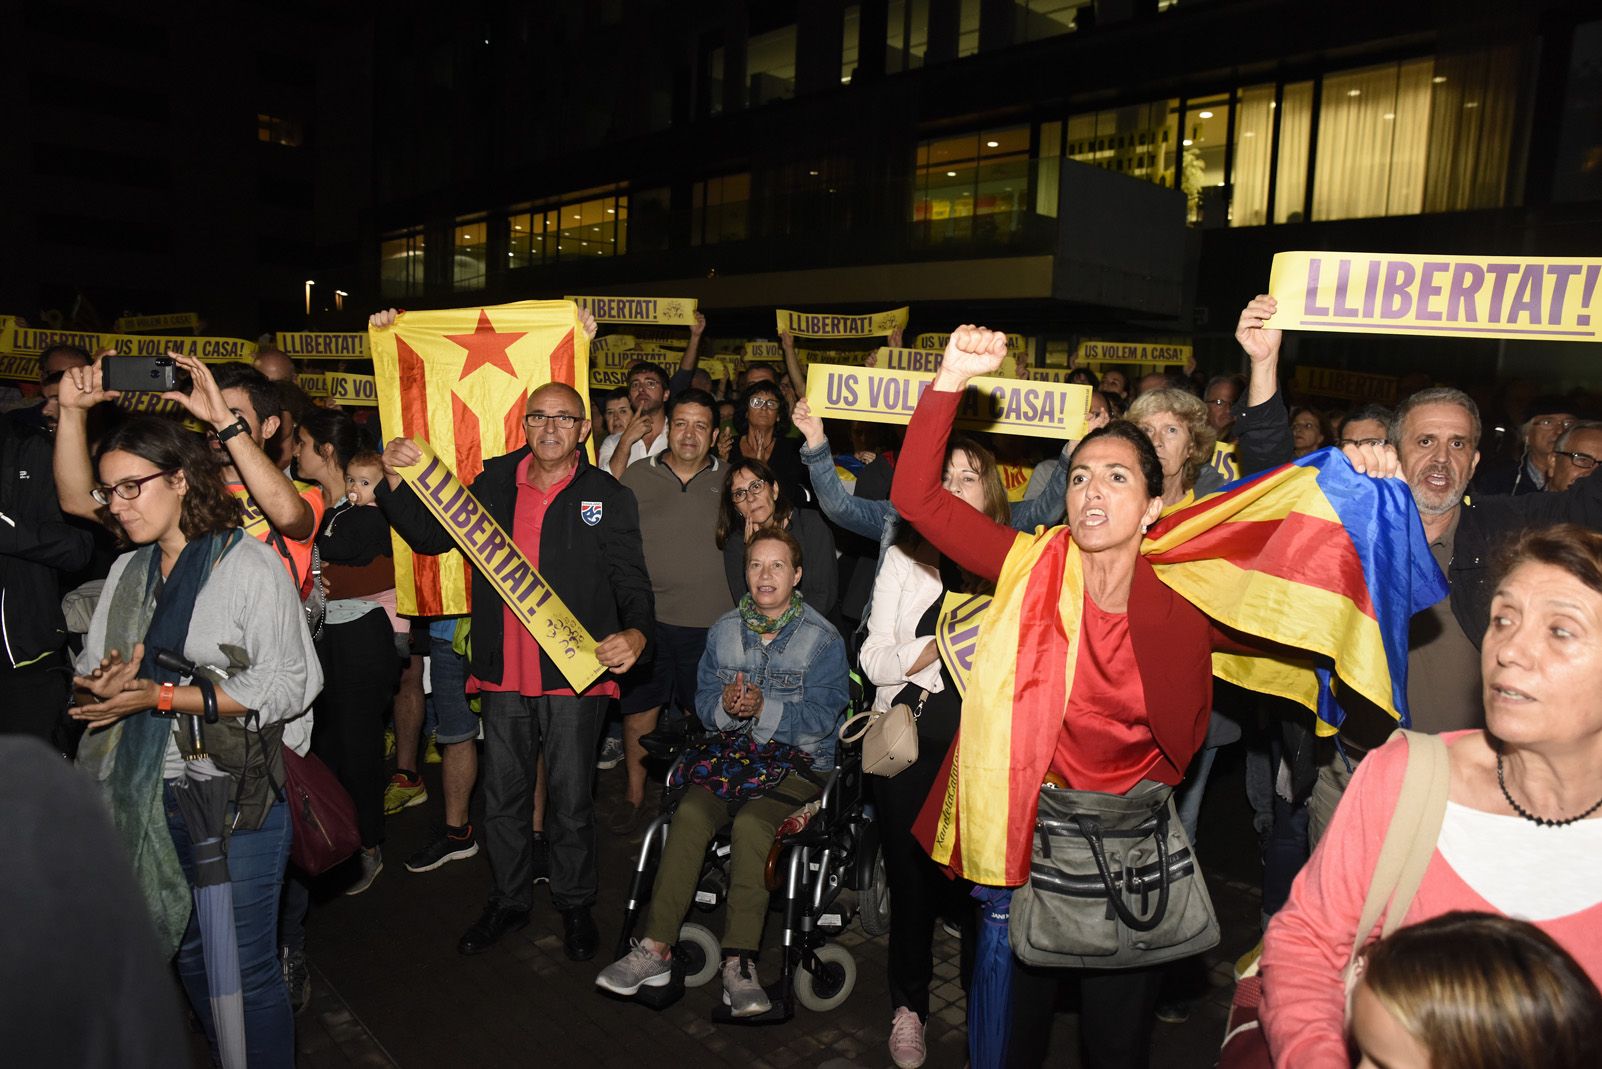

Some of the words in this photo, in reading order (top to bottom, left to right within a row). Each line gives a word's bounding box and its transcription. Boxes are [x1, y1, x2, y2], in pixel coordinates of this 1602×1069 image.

[1304, 258, 1601, 327] LLIBERTAT!
[575, 297, 657, 320] IBERTAT!
[789, 312, 873, 335] LLIBERTAT!
[115, 339, 133, 355] US
[138, 339, 185, 356] VOLEM
[188, 341, 198, 356] A
[203, 341, 245, 357] CASA!
[282, 334, 363, 355] LLIBERTAT!
[922, 335, 934, 348] US
[1085, 344, 1098, 358] US
[1102, 345, 1137, 359] VOLEM
[1141, 347, 1147, 360] A
[1151, 347, 1183, 361] CASA!
[331, 377, 348, 397] US
[827, 373, 859, 407] US
[868, 375, 931, 411] VOL
[962, 384, 978, 417] A
[989, 386, 1067, 424] CASA!
[417, 456, 553, 617] LLIBERTAT!
